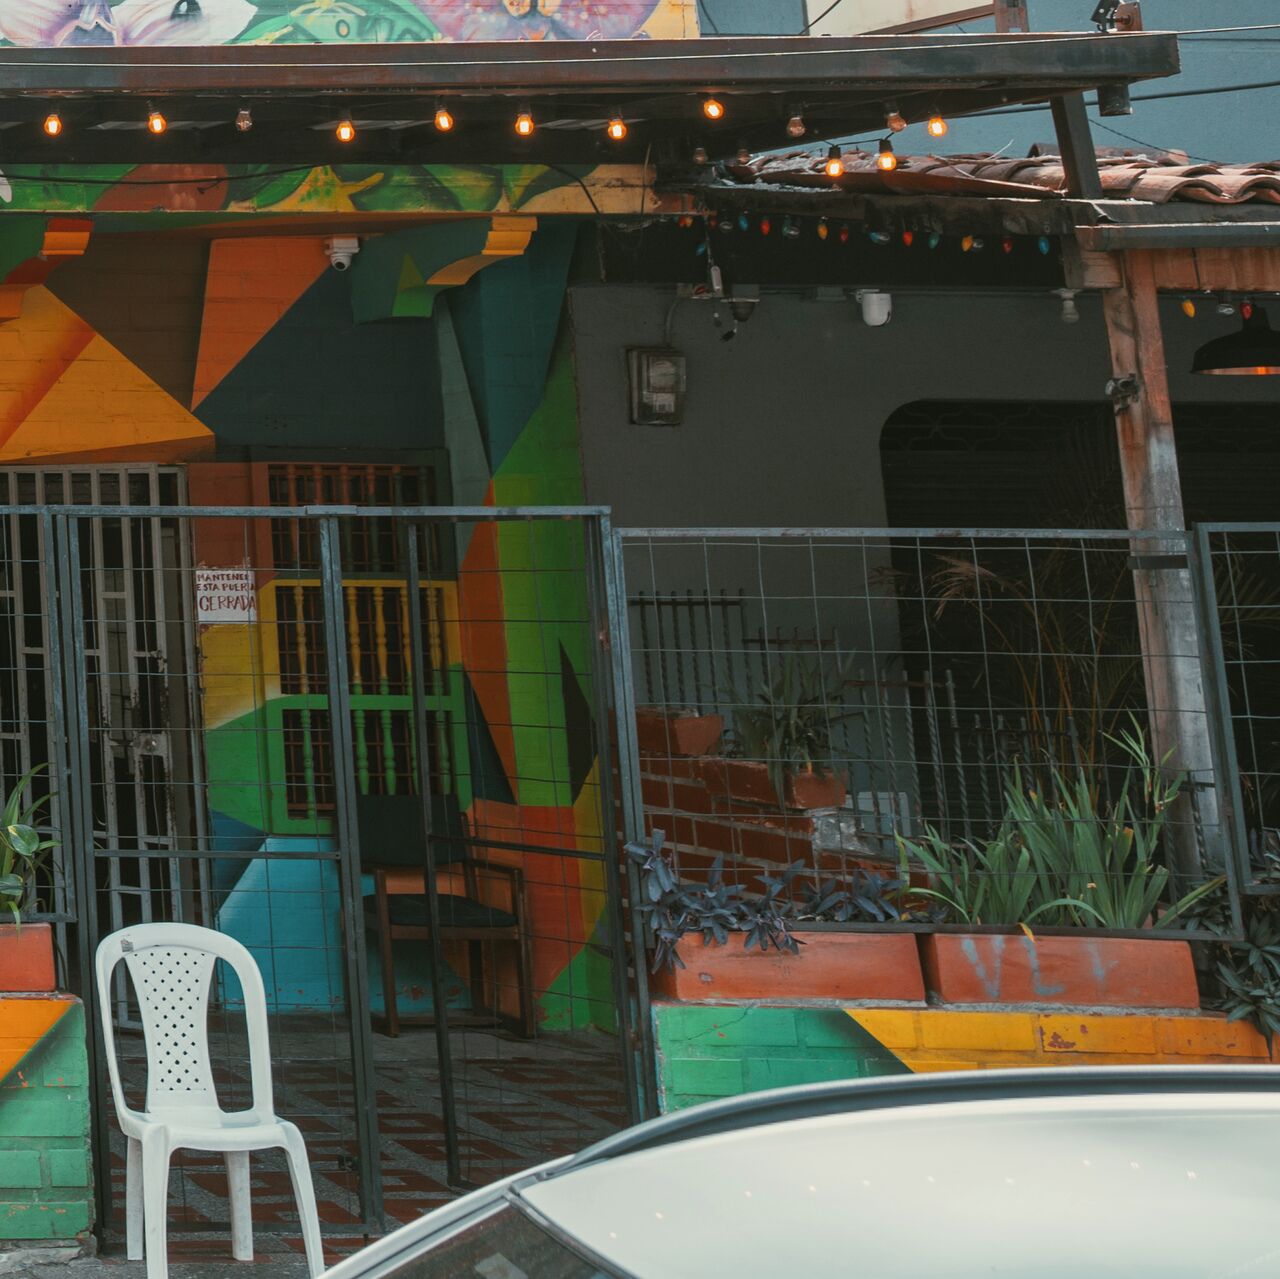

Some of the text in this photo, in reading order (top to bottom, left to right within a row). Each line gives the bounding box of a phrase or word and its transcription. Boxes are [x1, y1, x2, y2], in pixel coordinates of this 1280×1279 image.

[194, 583, 257, 592] ESTA PUERA
[199, 594, 257, 612] CERRADA
